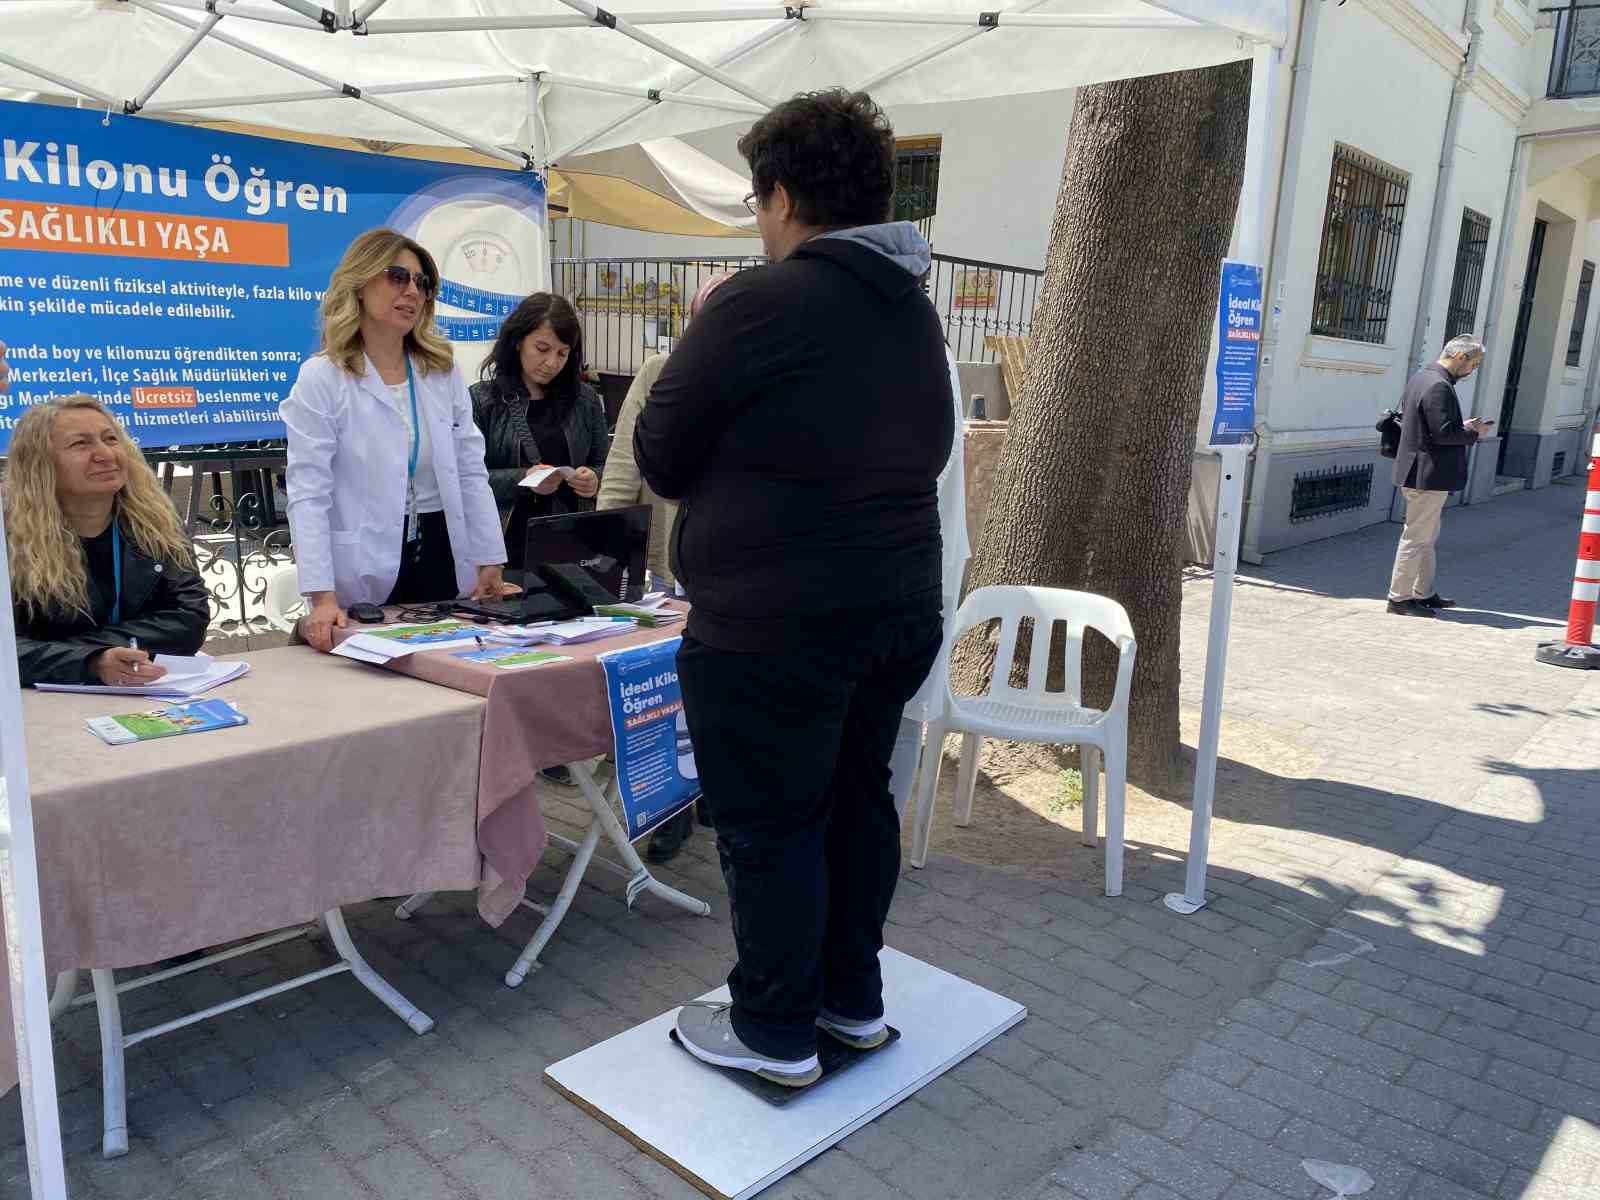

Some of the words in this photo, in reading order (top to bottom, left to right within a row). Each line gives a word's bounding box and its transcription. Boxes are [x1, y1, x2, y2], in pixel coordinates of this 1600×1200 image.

[4, 138, 187, 198] Kilonu
[204, 153, 347, 215] Öğren
[0, 206, 145, 247] SAĞLIKLI
[155, 221, 230, 258] YAŞA
[28, 277, 47, 288] ve
[52, 274, 110, 292] düzenli
[114, 278, 166, 294] fiziksel
[170, 281, 249, 300] aktiviteyle,
[253, 284, 285, 299] fazla
[288, 286, 312, 301] kilo
[28, 297, 86, 316] şekilde
[91, 300, 163, 316] mücadele
[167, 302, 235, 319] edilebilir.
[52, 344, 81, 363] boy
[85, 348, 102, 360] ve
[106, 345, 171, 361] kilonuzu
[174, 346, 258, 364] öğrendikten
[261, 351, 301, 364] sonra;
[7, 367, 98, 385] Merkezleri,
[102, 364, 129, 386] İlçe
[133, 368, 178, 386] Sağlık
[182, 368, 269, 382] Müdürlükleri
[272, 370, 287, 382] ve
[135, 387, 193, 404] Ücretsiz
[196, 389, 261, 404] beslenme
[264, 391, 279, 402] ve
[134, 411, 209, 426] hizmetleri
[620, 676, 654, 698] İdeal
[655, 671, 678, 688] Kilo
[623, 694, 663, 714] Öğren
